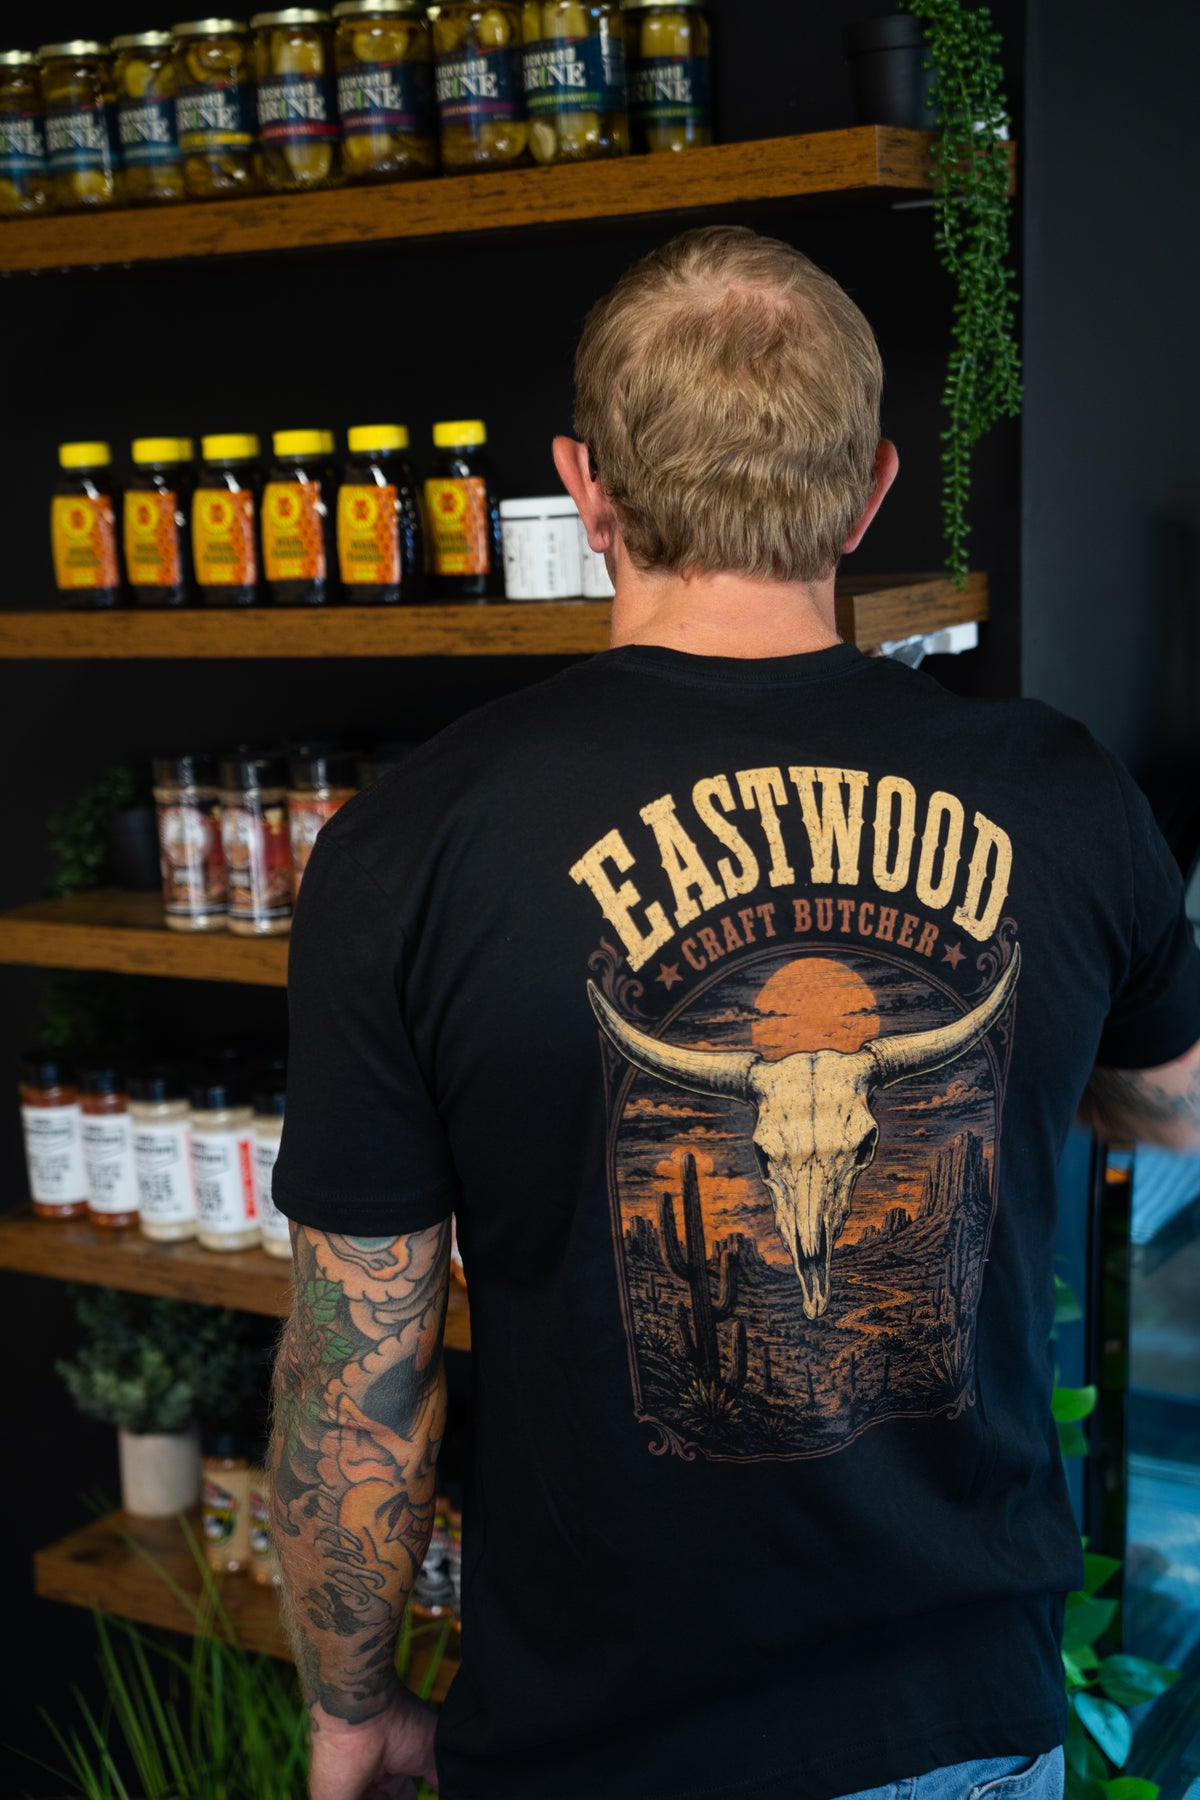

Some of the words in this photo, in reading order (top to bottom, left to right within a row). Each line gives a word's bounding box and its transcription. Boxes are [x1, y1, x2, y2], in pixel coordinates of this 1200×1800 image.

[568, 766, 1013, 972] EASTWOOD
[681, 902, 776, 971] CRAFT
[792, 898, 940, 957] BUTCHER
